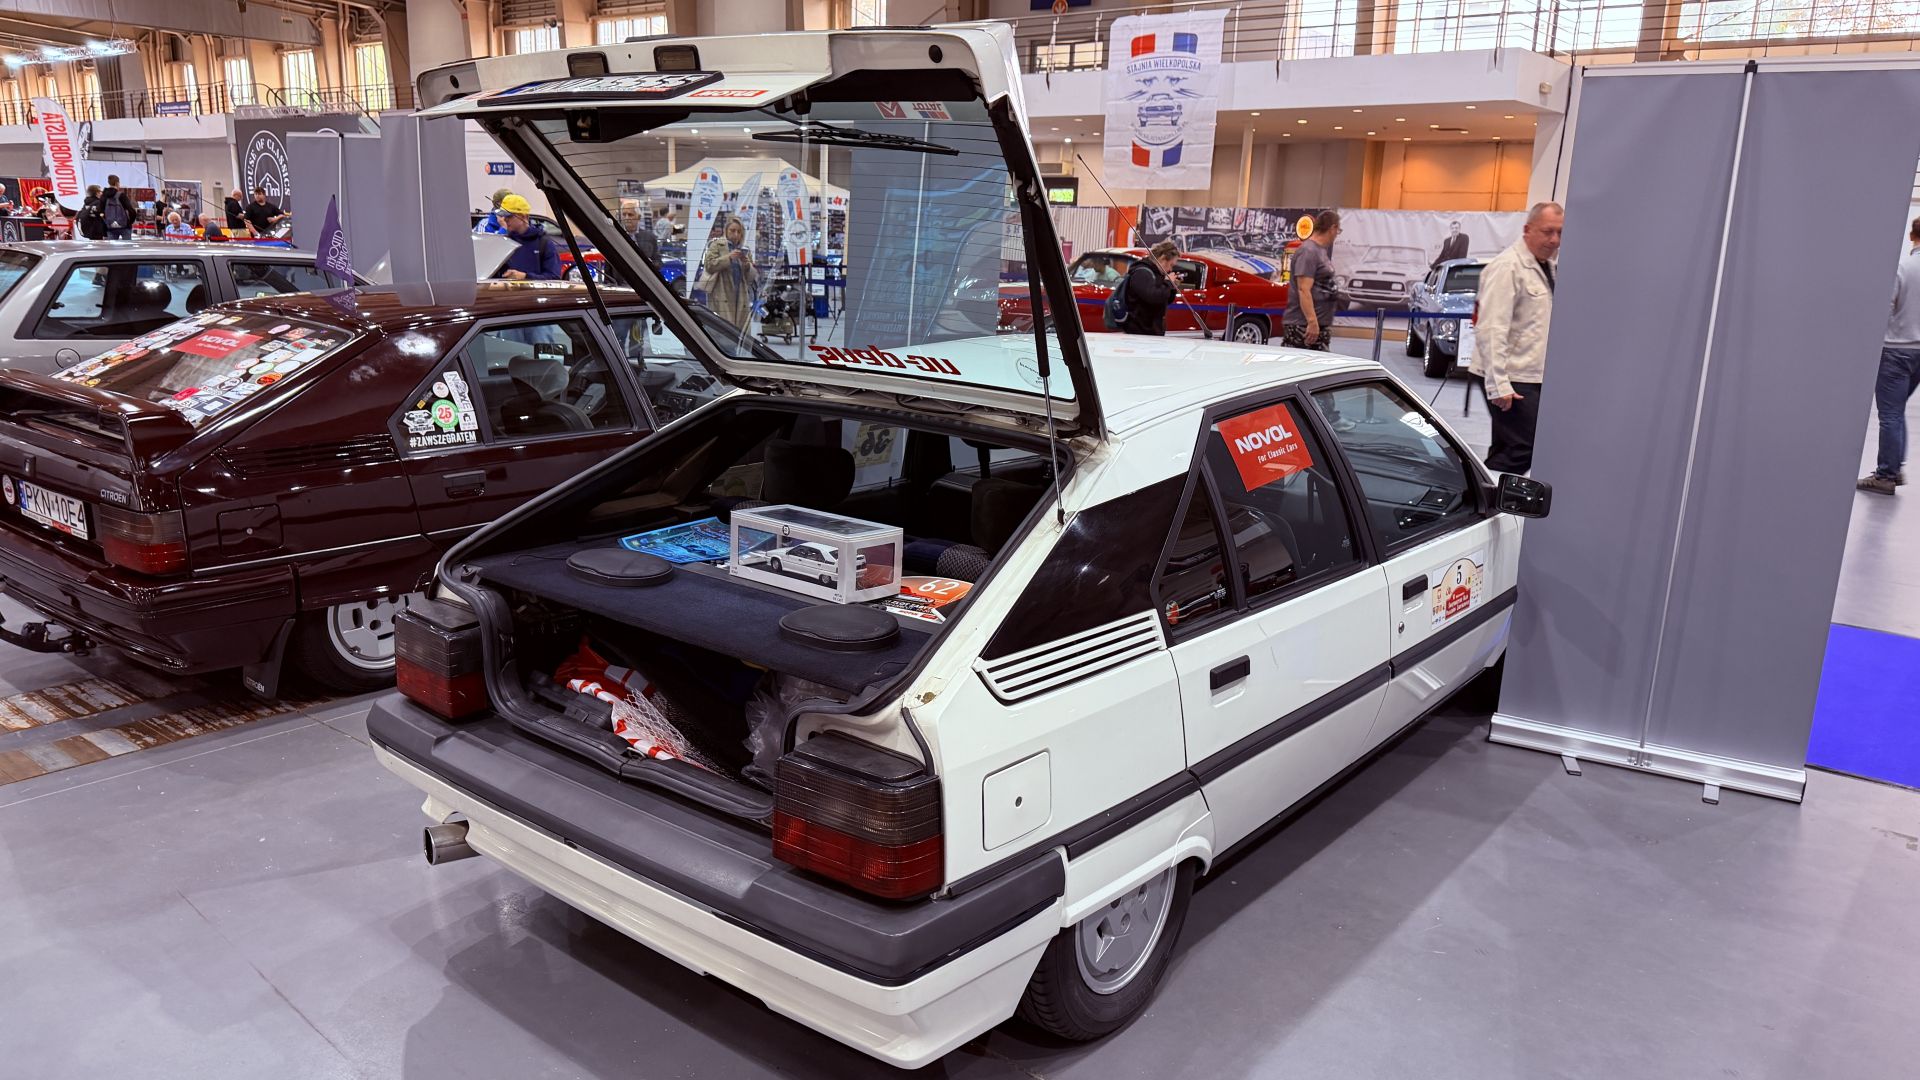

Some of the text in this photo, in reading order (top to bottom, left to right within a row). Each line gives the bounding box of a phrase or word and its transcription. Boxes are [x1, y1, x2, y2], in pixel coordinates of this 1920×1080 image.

[1126, 57, 1202, 75] STAJNIA WIELKOPOLSKA
[247, 138, 292, 197] HOUSE OF CLASSICS
[437, 407, 452, 419] 25
[409, 430, 477, 448] #ZAWSZEGRATEM
[1234, 424, 1293, 454] NOVOL
[1267, 446, 1286, 460] Classic
[1285, 442, 1298, 453] Cars
[24, 483, 52, 518] PKN
[55, 495, 87, 531] 10E4
[1456, 564, 1462, 585] 5
[918, 578, 960, 596] 62
